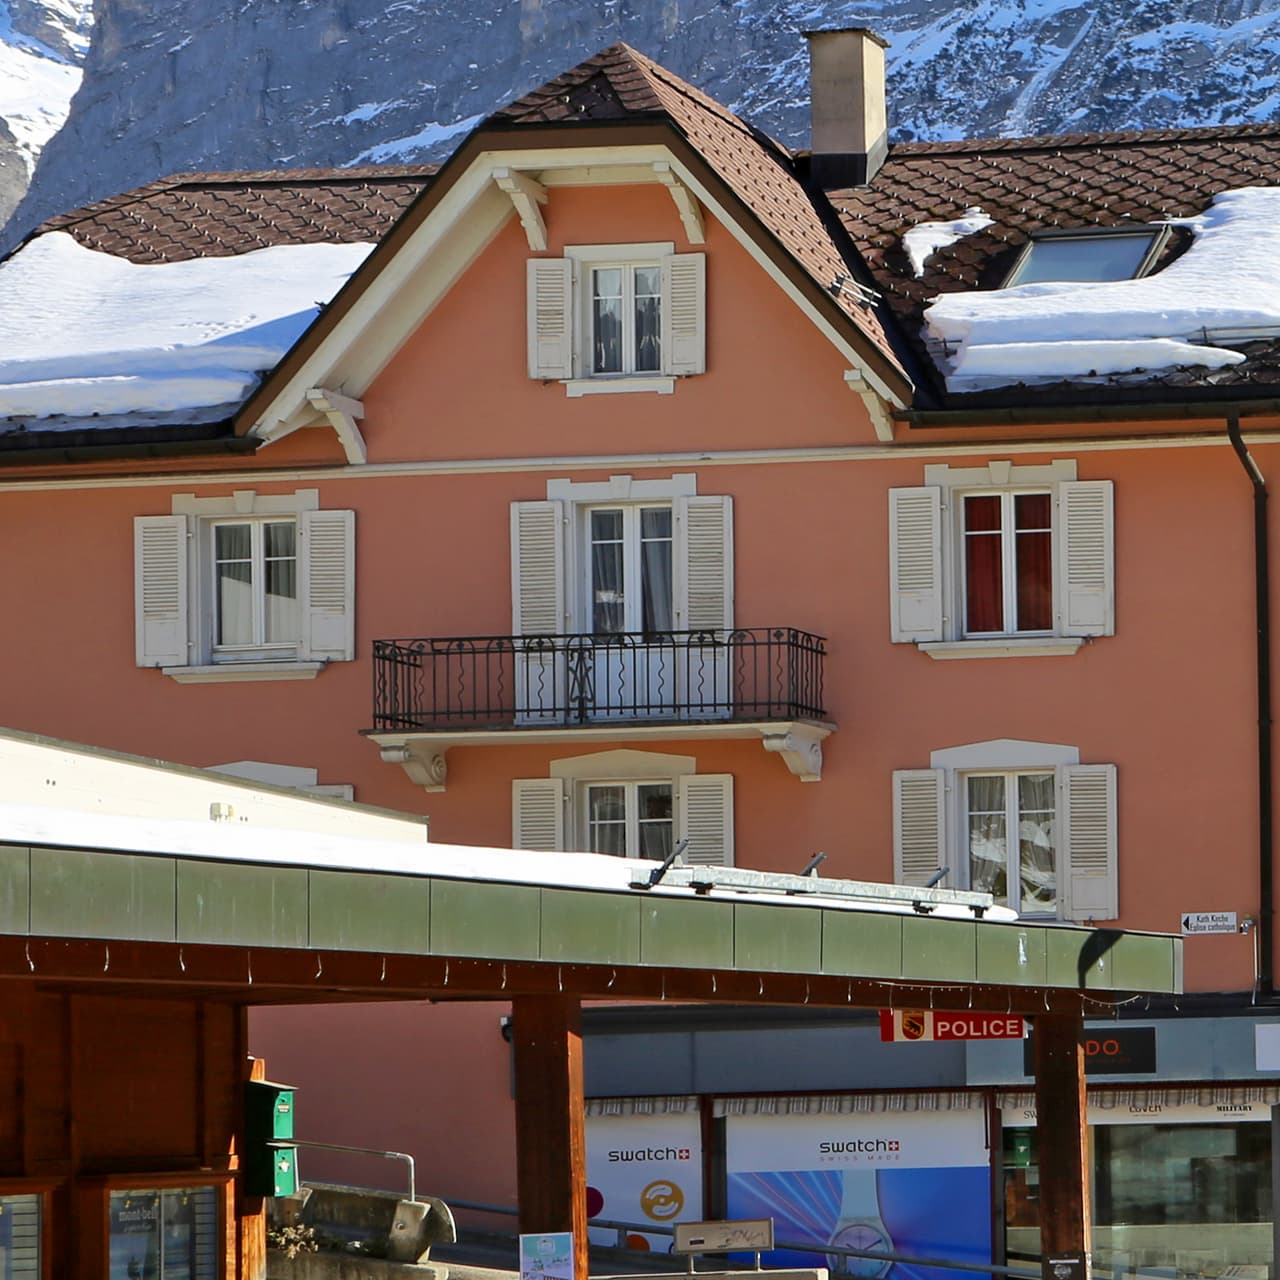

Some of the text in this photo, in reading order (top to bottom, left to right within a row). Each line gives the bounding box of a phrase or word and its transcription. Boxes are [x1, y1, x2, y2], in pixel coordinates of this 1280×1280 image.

[937, 1019, 1019, 1037] POLICE
[1086, 1039, 1120, 1056] DO
[1023, 1110, 1038, 1120] SW
[820, 1139, 887, 1154] swatch
[608, 1147, 676, 1162] swatch
